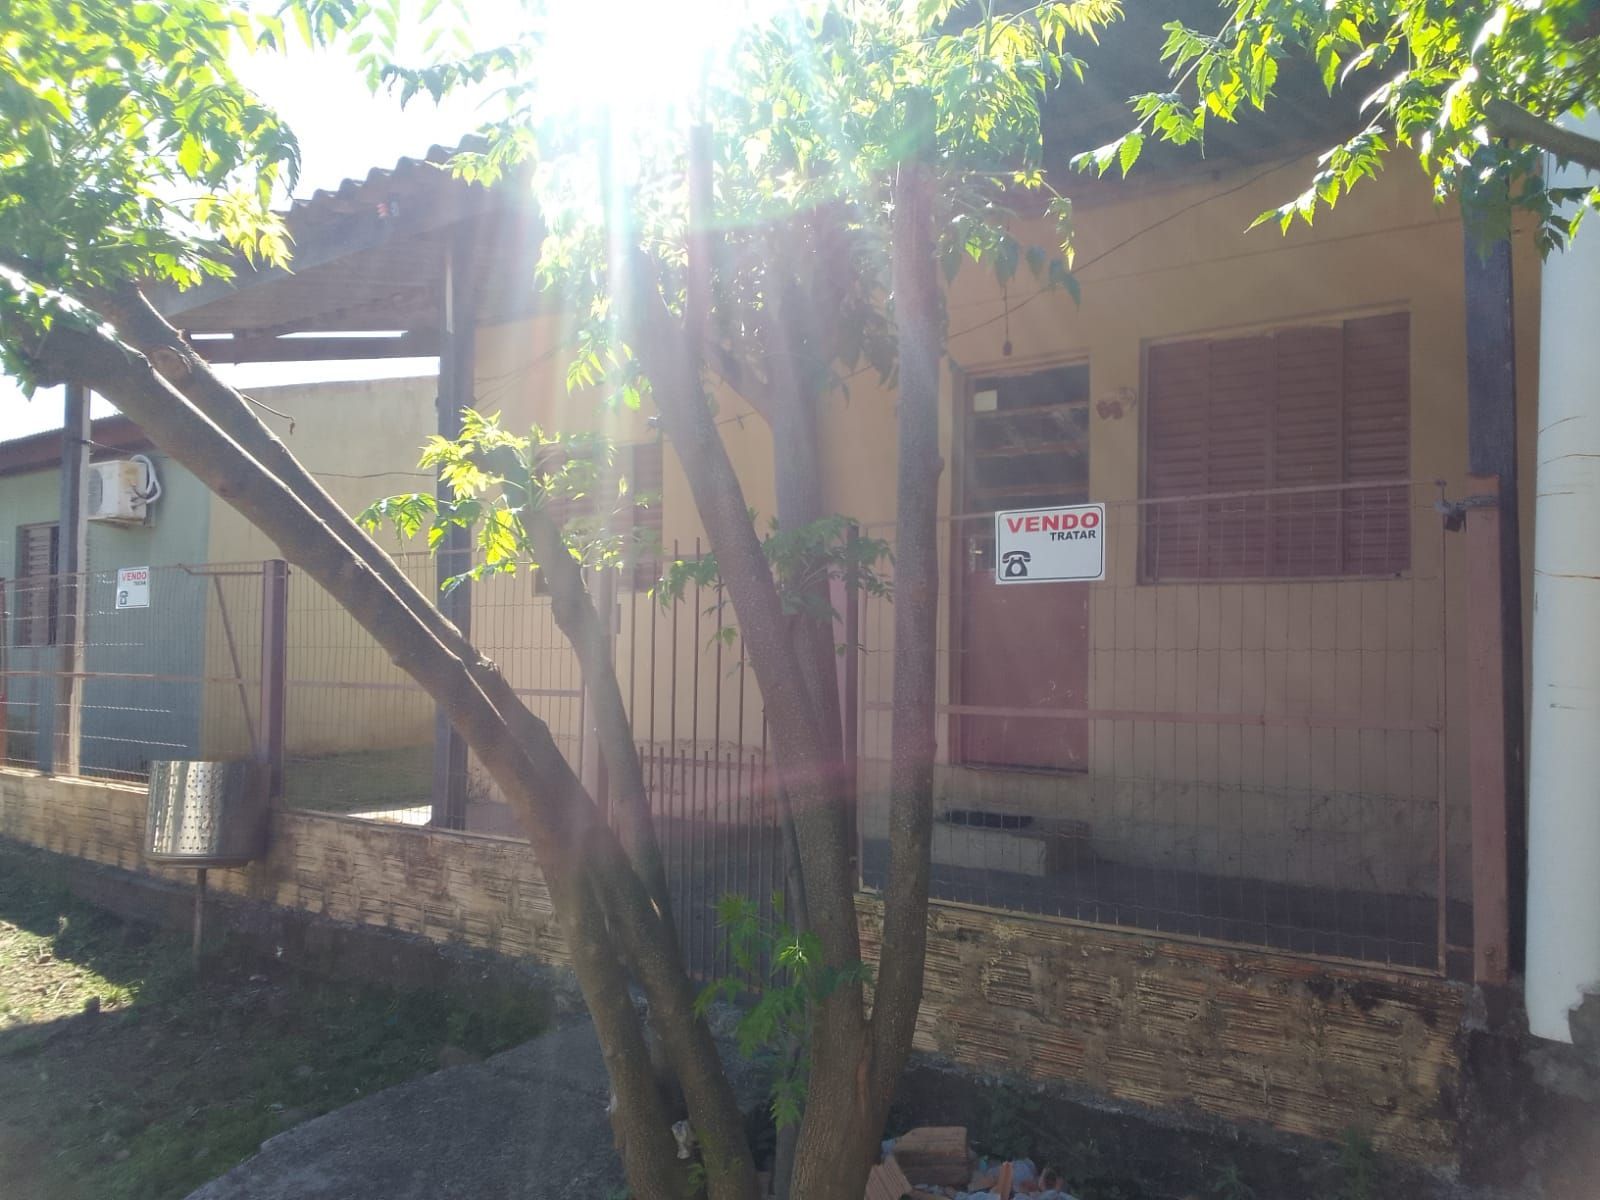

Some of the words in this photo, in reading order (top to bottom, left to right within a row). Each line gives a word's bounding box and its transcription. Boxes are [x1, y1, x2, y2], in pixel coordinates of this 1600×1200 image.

[1006, 512, 1100, 534] VENDO
[1050, 529, 1096, 542] TRATAR
[121, 571, 147, 581] VENDO
